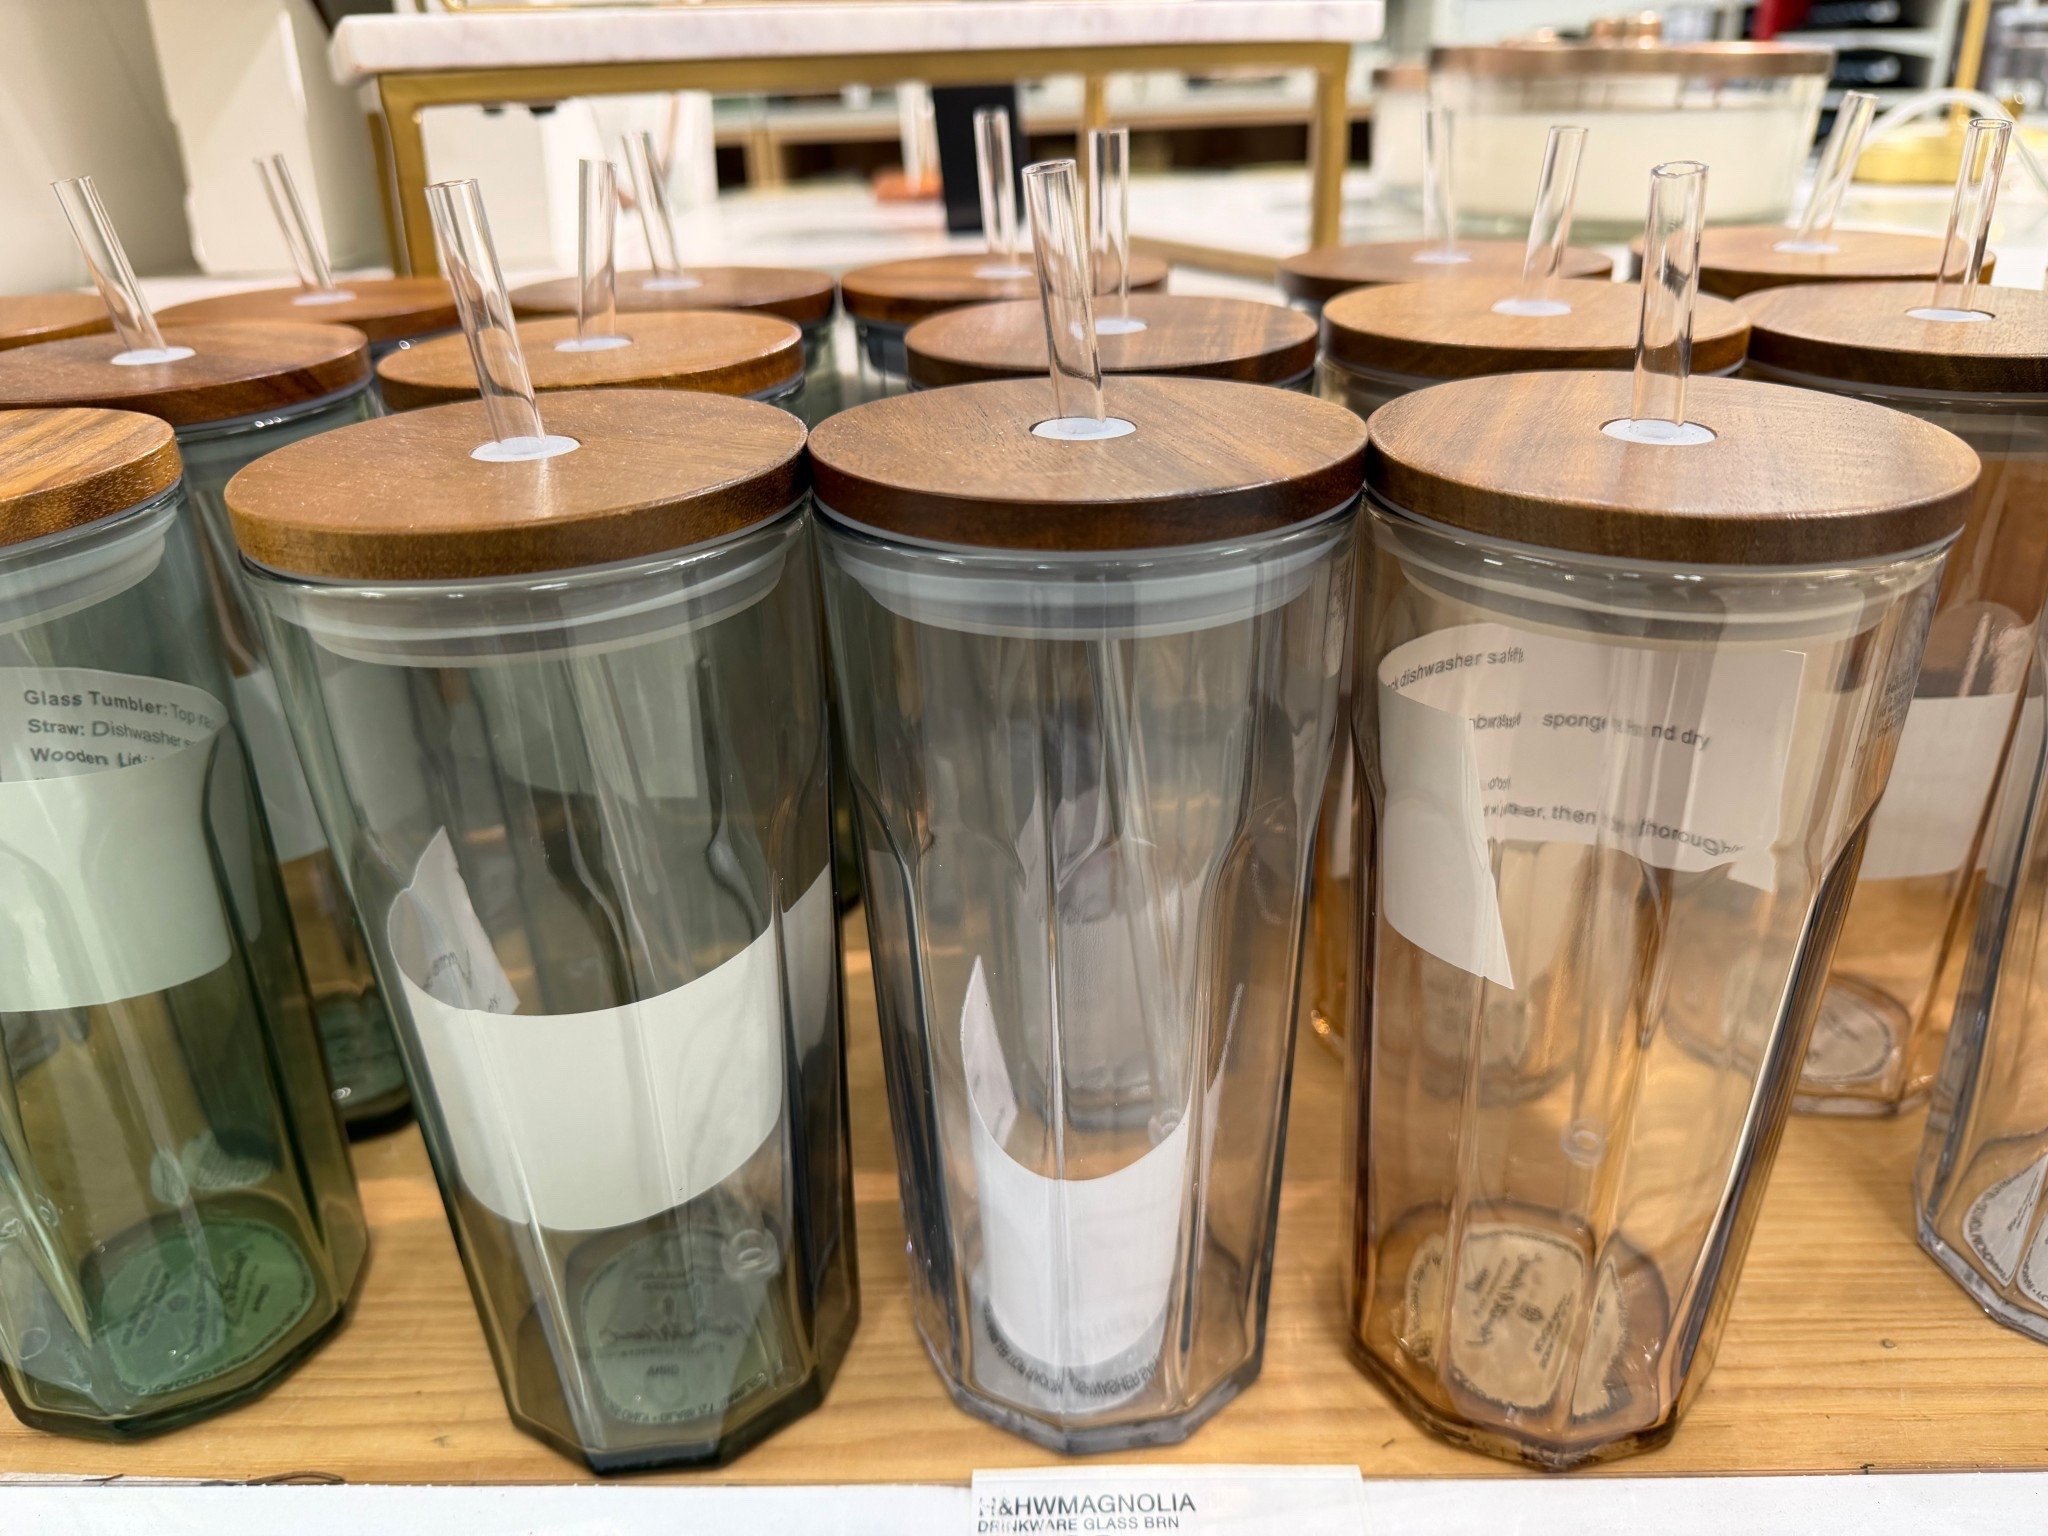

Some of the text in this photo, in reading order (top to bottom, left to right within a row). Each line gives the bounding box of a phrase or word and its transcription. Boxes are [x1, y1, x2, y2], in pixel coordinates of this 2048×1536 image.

[1400, 651, 1482, 688] dishwasher
[24, 689, 82, 706] Glass
[88, 690, 168, 715] Tumbler:
[170, 702, 196, 727] Top
[27, 718, 85, 736] Straw:
[91, 720, 182, 748] Dishwasher
[1681, 728, 1711, 752] dry
[30, 747, 108, 765] Wooden
[1551, 805, 1598, 824] then
[1083, 1515, 1139, 1531] GLASS
[1144, 1514, 1179, 1529] BRN
